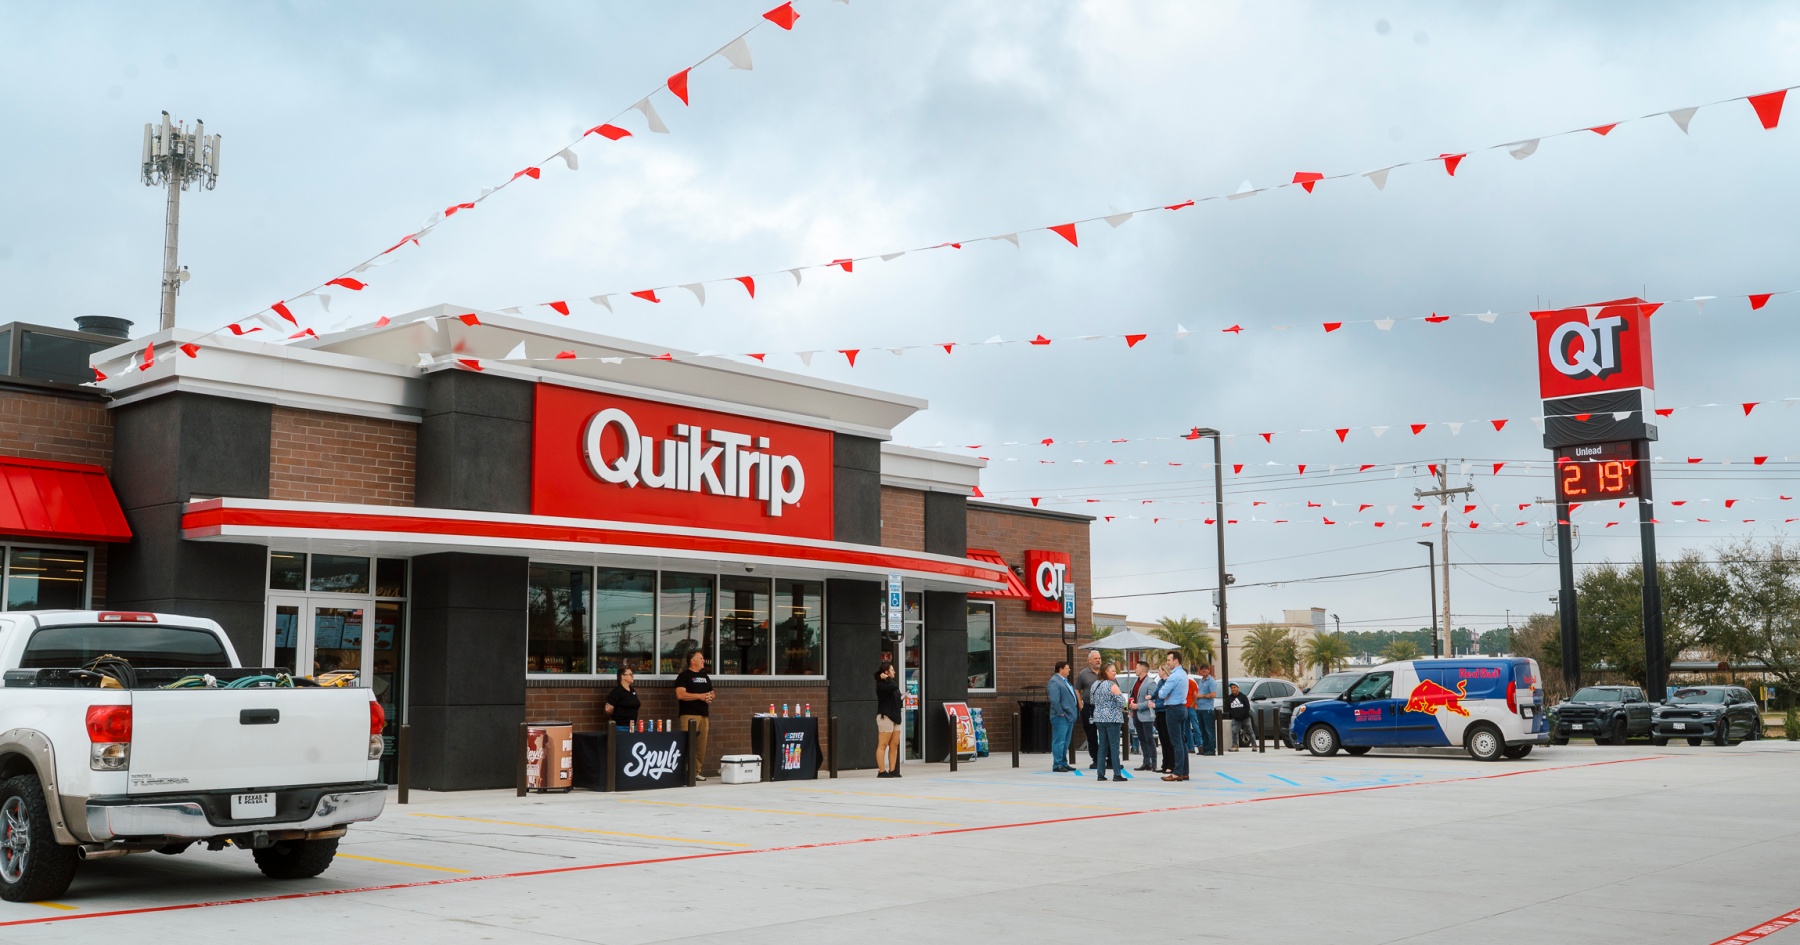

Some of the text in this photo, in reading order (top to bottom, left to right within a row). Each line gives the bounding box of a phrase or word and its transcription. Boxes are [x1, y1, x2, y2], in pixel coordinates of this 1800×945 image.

[1548, 316, 1624, 379] QT
[583, 407, 805, 517] QuikTrip
[1575, 446, 1602, 456] Unlead
[1036, 561, 1066, 601] QT
[1459, 667, 1501, 678] Red Bull
[623, 740, 682, 780] Spylt
